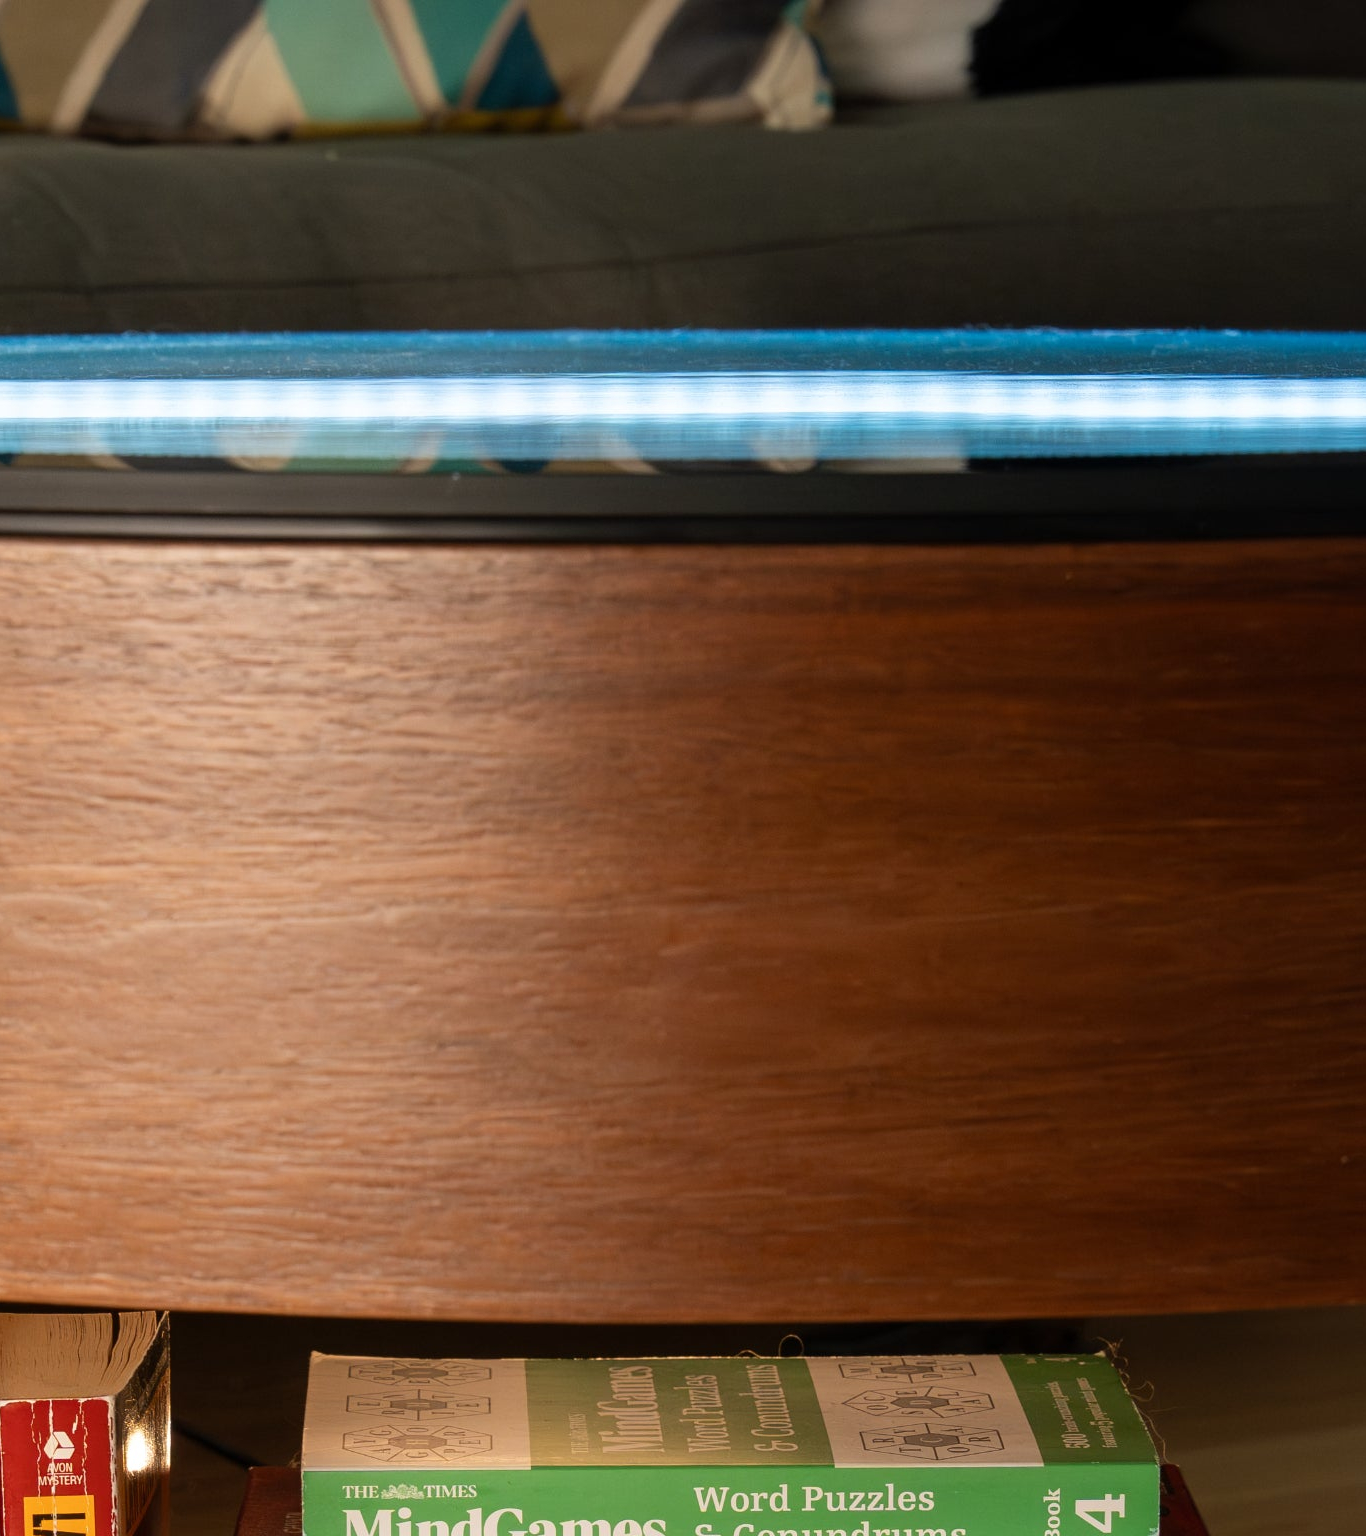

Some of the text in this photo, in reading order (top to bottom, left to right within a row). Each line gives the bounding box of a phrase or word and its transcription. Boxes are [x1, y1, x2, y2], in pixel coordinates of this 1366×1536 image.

[597, 1366, 664, 1452] MindGames
[673, 1374, 731, 1452] Word Puzzles
[739, 1364, 794, 1437] Conundrums
[1061, 1434, 1090, 1448] 500
[37, 1474, 83, 1486] MYSTERY
[47, 1462, 73, 1474] AVON
[342, 1484, 477, 1499] THE TIMES
[693, 1483, 935, 1512] Word Puzzles
[1075, 1494, 1125, 1534] 4
